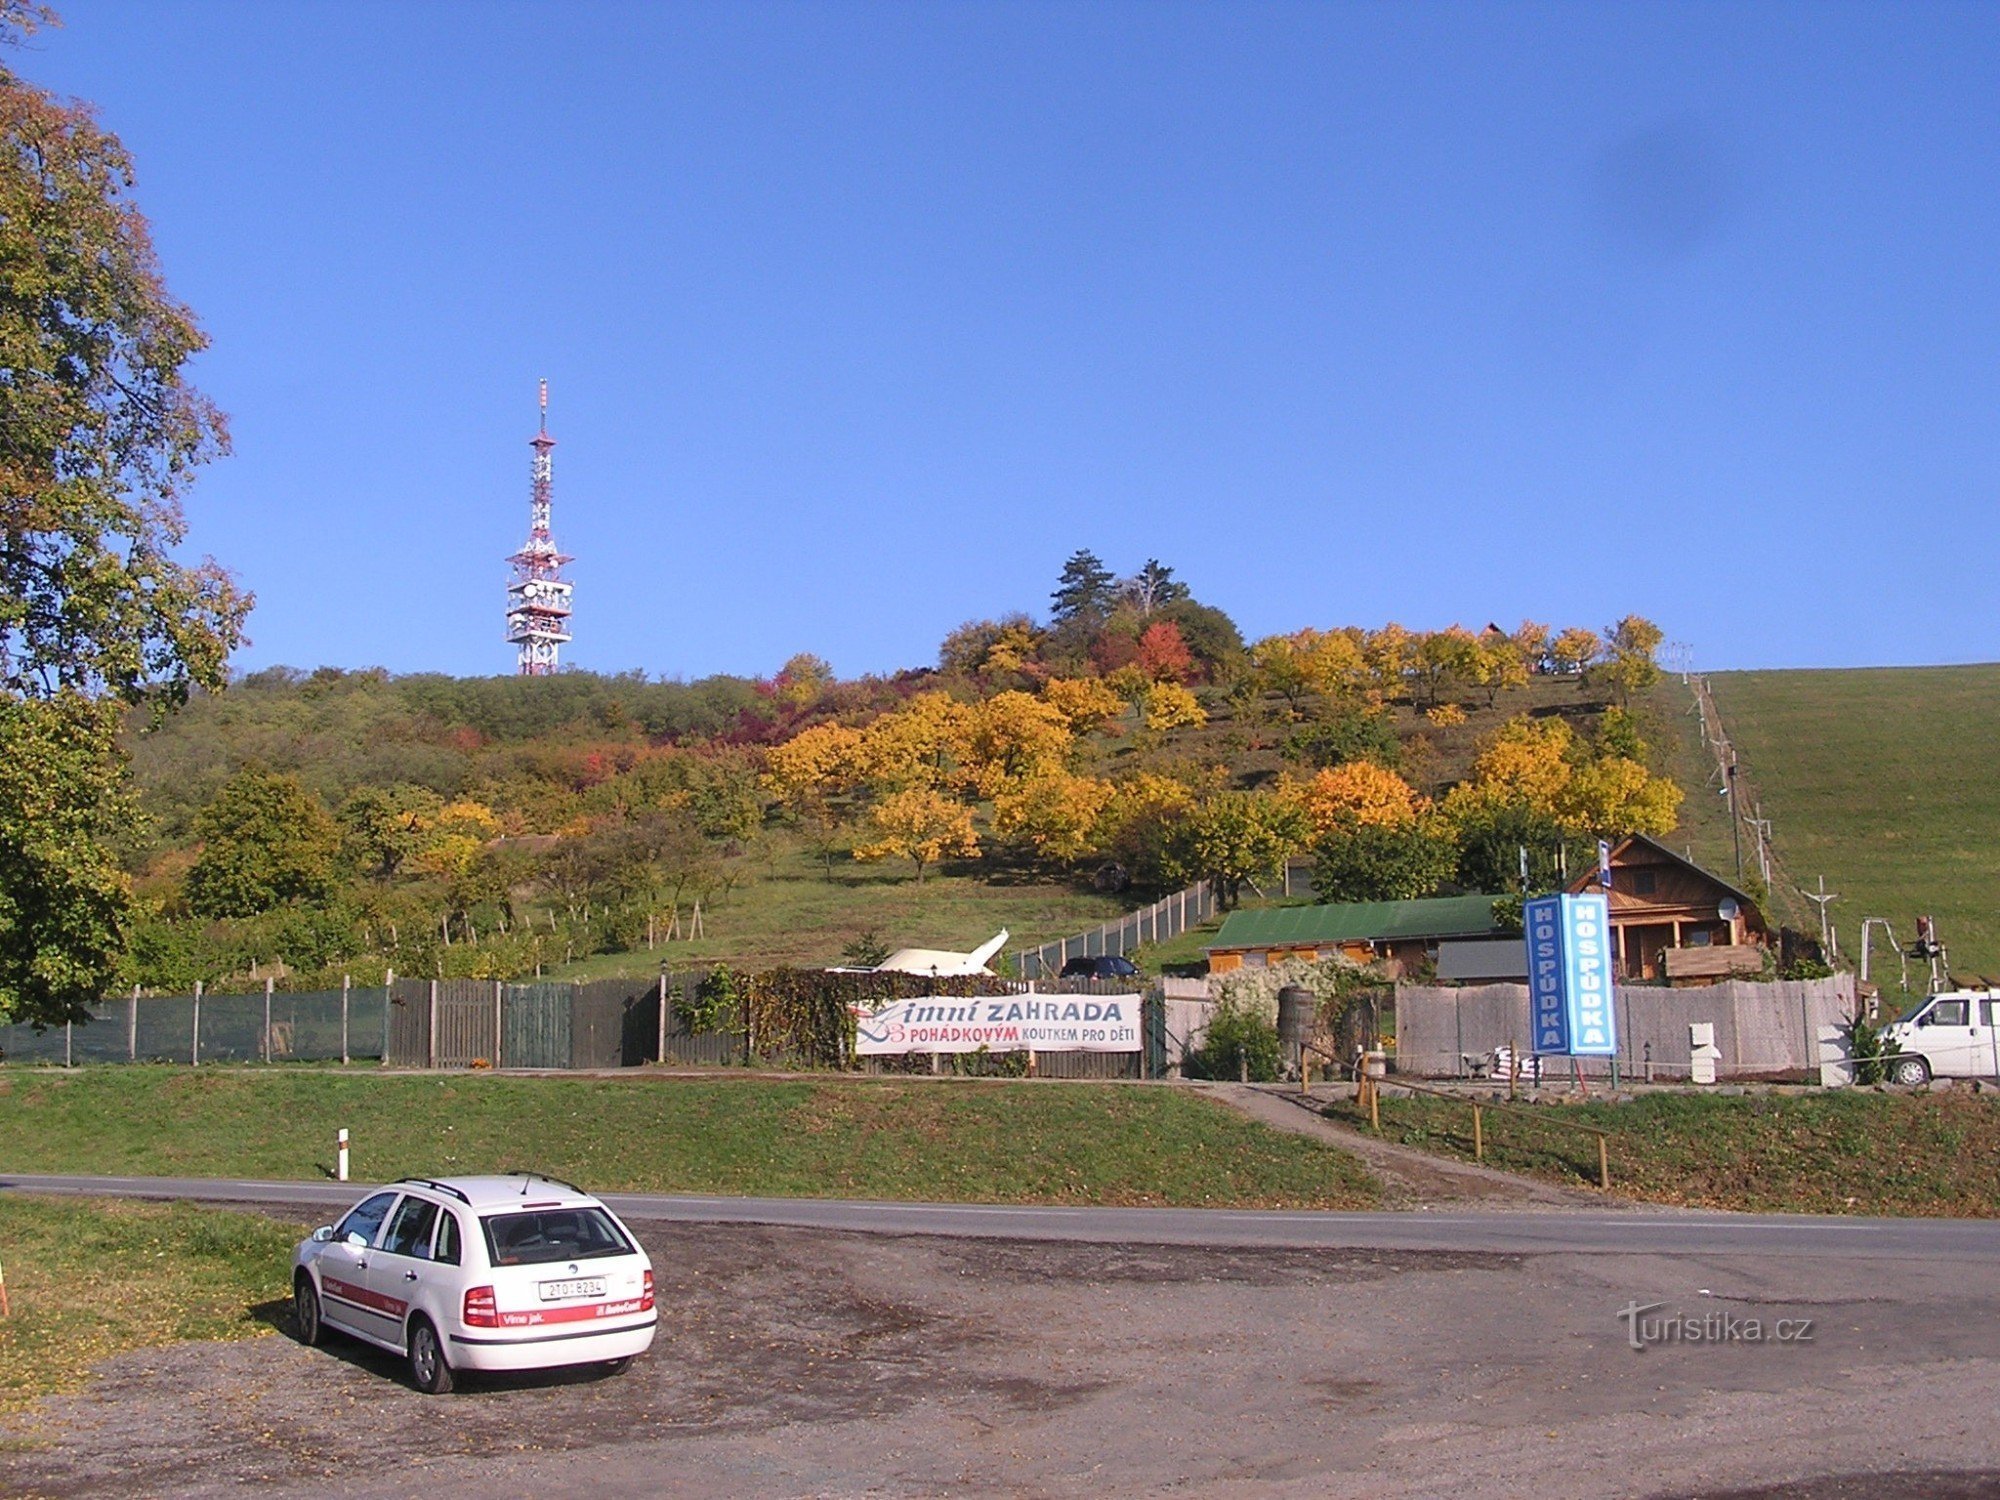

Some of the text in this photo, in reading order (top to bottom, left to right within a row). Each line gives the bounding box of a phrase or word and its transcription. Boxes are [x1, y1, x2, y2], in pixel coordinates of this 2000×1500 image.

[987, 1001, 1122, 1021] ZAHRADA
[910, 1023, 1019, 1042] POHÁDKOVÝM
[1022, 1028, 1078, 1040] KOUTKEM
[1082, 1029, 1105, 1041] PRO
[1110, 1025, 1134, 1040] DĚTI
